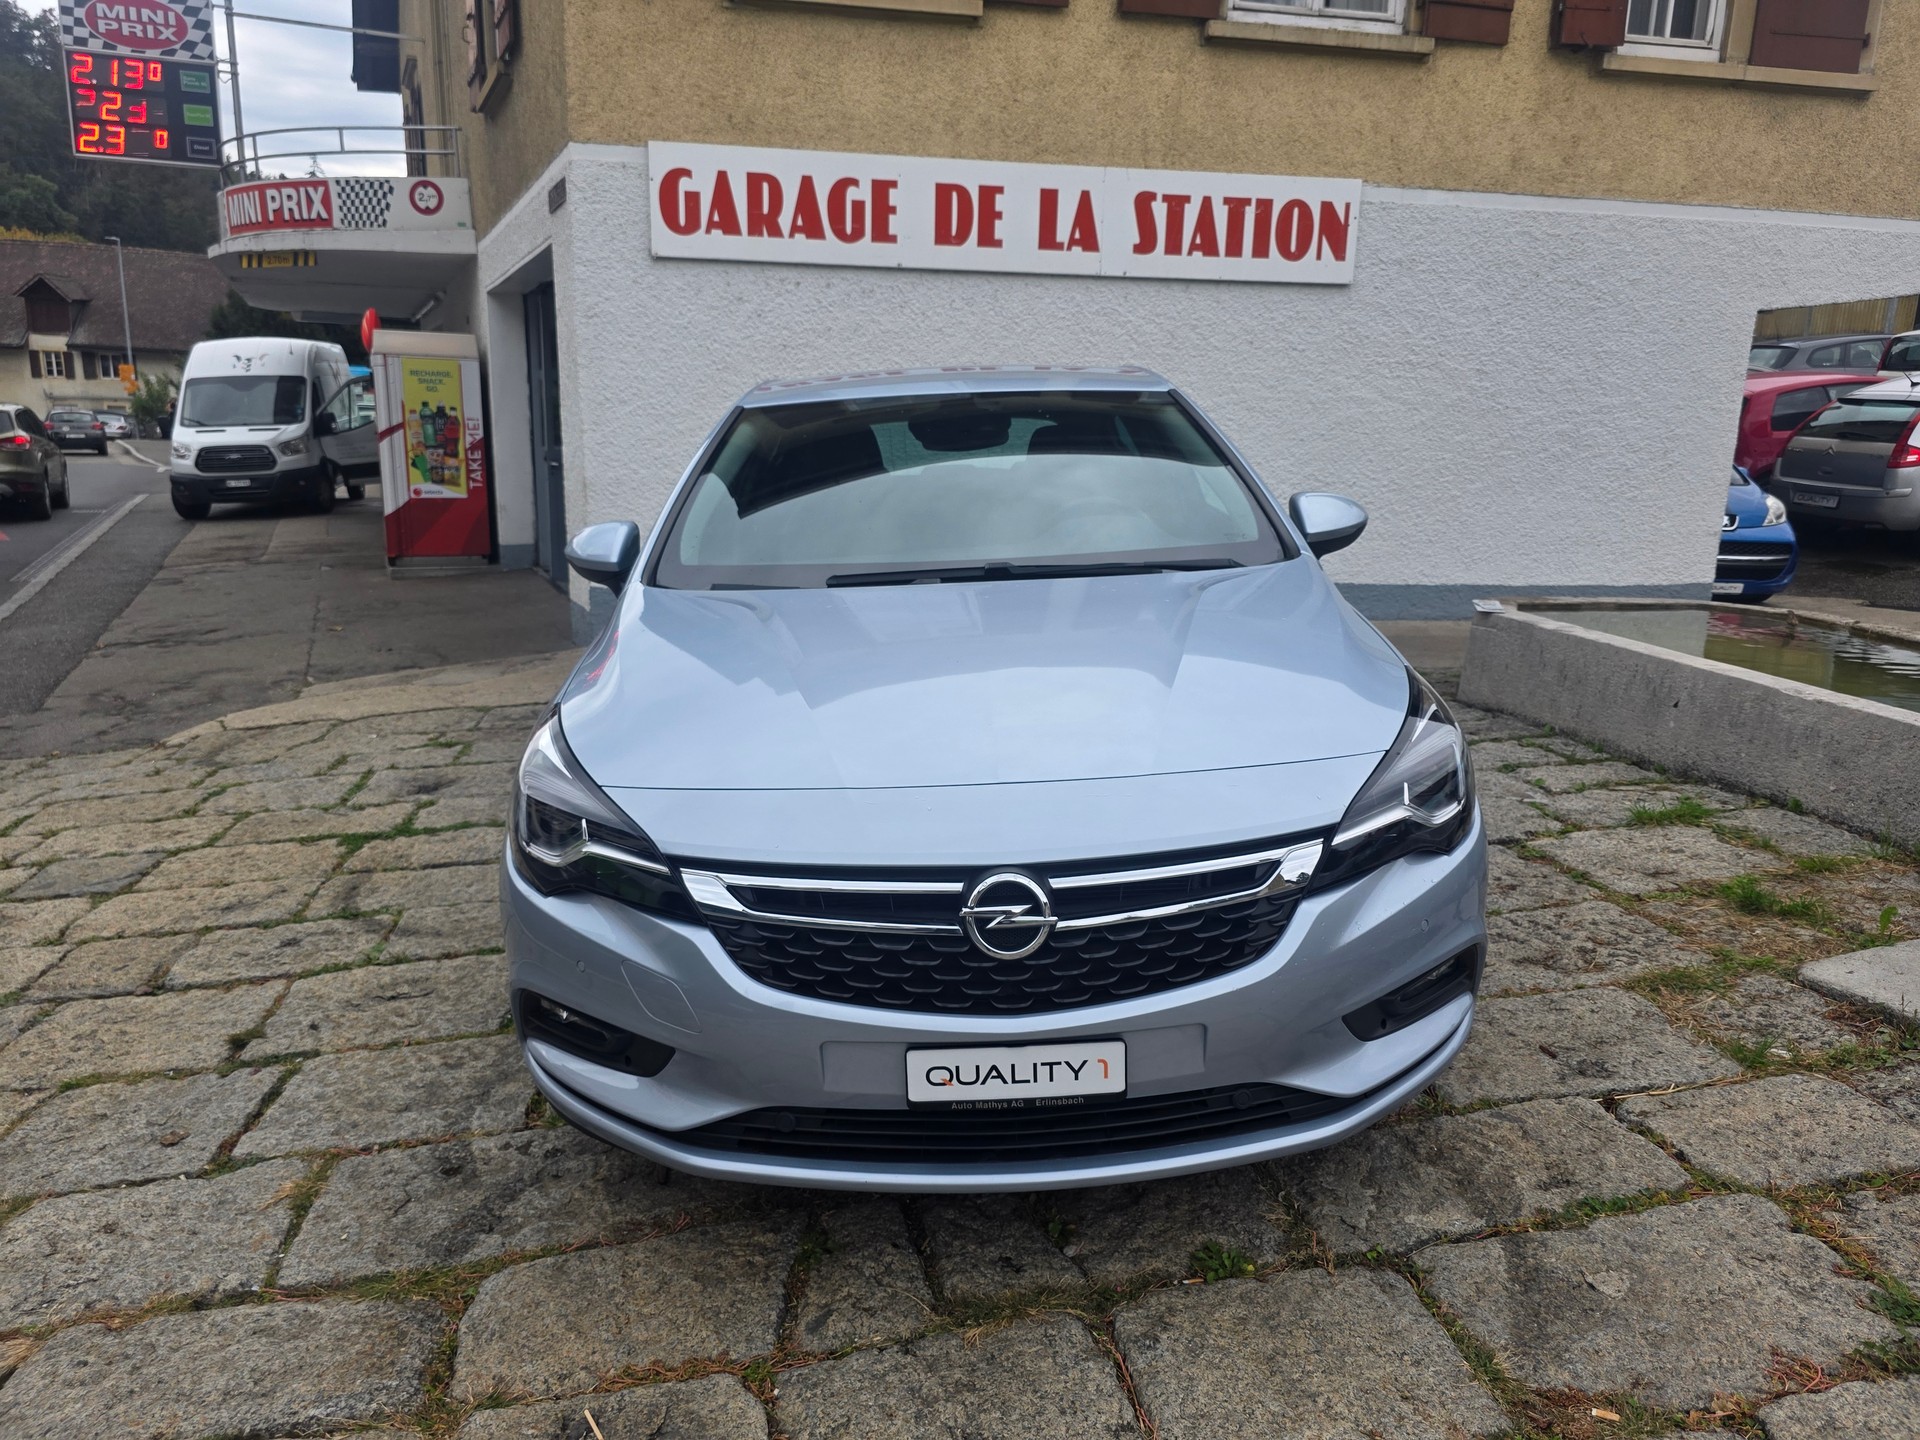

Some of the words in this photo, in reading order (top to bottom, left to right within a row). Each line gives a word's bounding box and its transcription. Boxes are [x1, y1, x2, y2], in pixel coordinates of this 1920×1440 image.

[96, 2, 177, 26] MINI
[98, 19, 178, 42] PRIX
[228, 190, 262, 227] MINI
[266, 186, 329, 222] PRIX
[658, 167, 899, 245] GARAGE
[934, 182, 1006, 249] DE
[1037, 188, 1101, 253] LA
[1131, 190, 1351, 262] STATION
[466, 417, 480, 448] ME!
[469, 450, 483, 489] TAKE
[925, 1059, 1089, 1087] QUALITY
[1097, 1058, 1109, 1079] 1
[951, 1101, 973, 1110] Auto
[975, 1100, 1008, 1110] Mathys
[1010, 1100, 1025, 1108] AG
[1035, 1097, 1085, 1107] Erlinsbach
